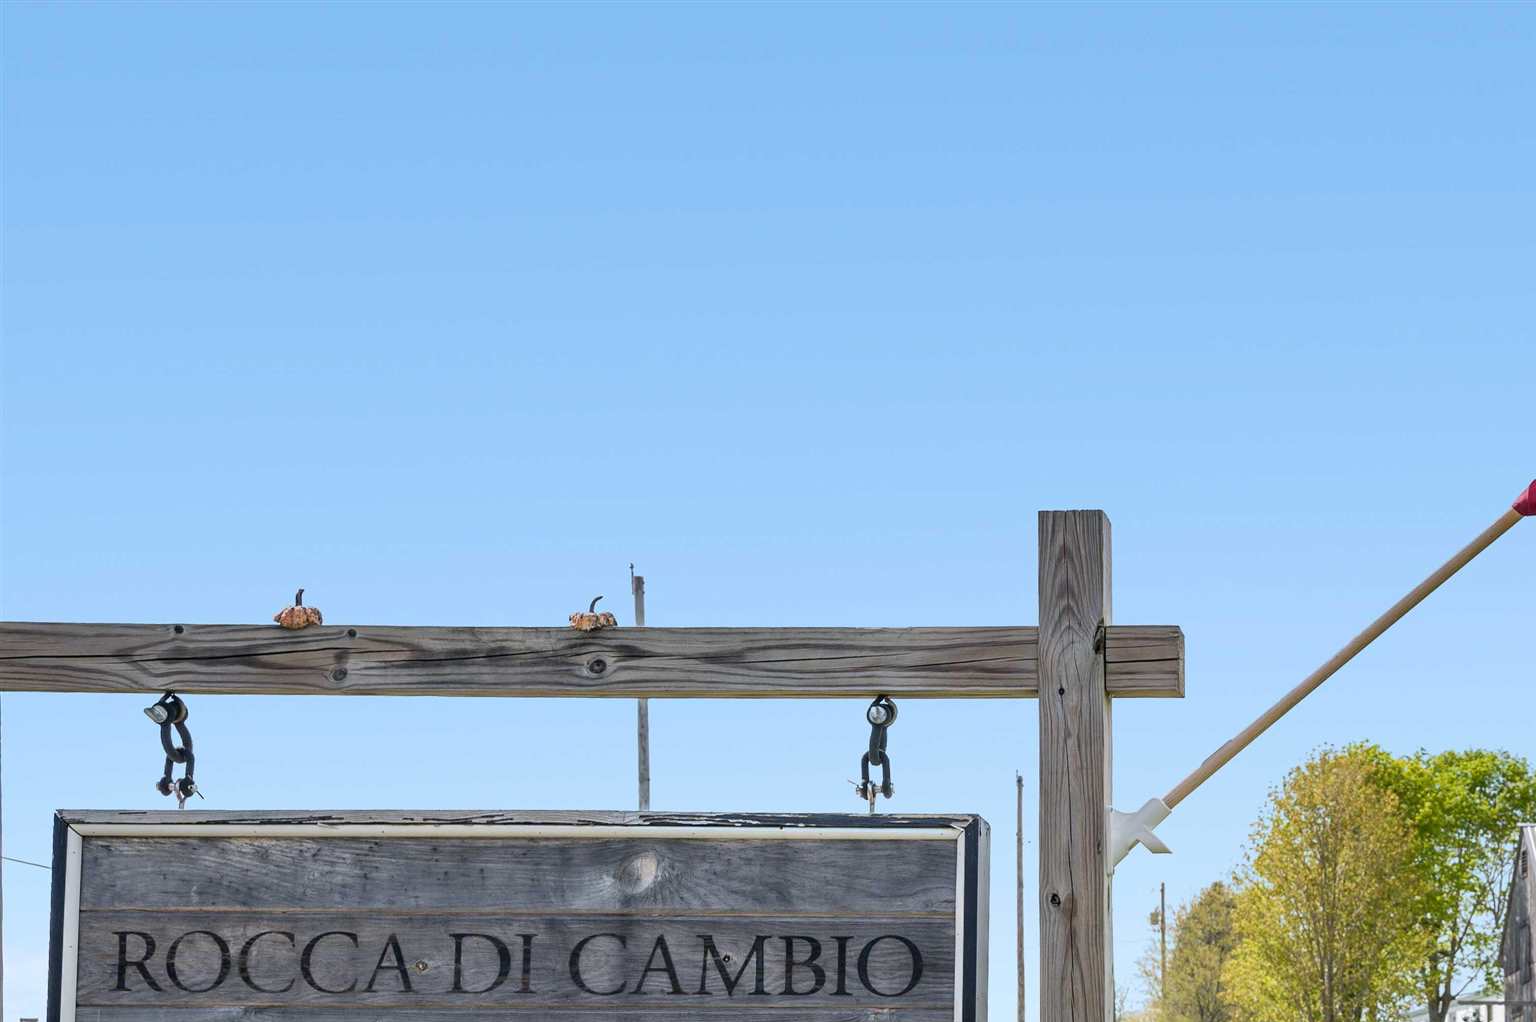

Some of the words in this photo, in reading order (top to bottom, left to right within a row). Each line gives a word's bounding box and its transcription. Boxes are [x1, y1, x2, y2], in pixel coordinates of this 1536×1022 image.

[109, 930, 418, 993] ROCCA
[448, 932, 538, 994] DI
[568, 933, 924, 997] CAMBIO
